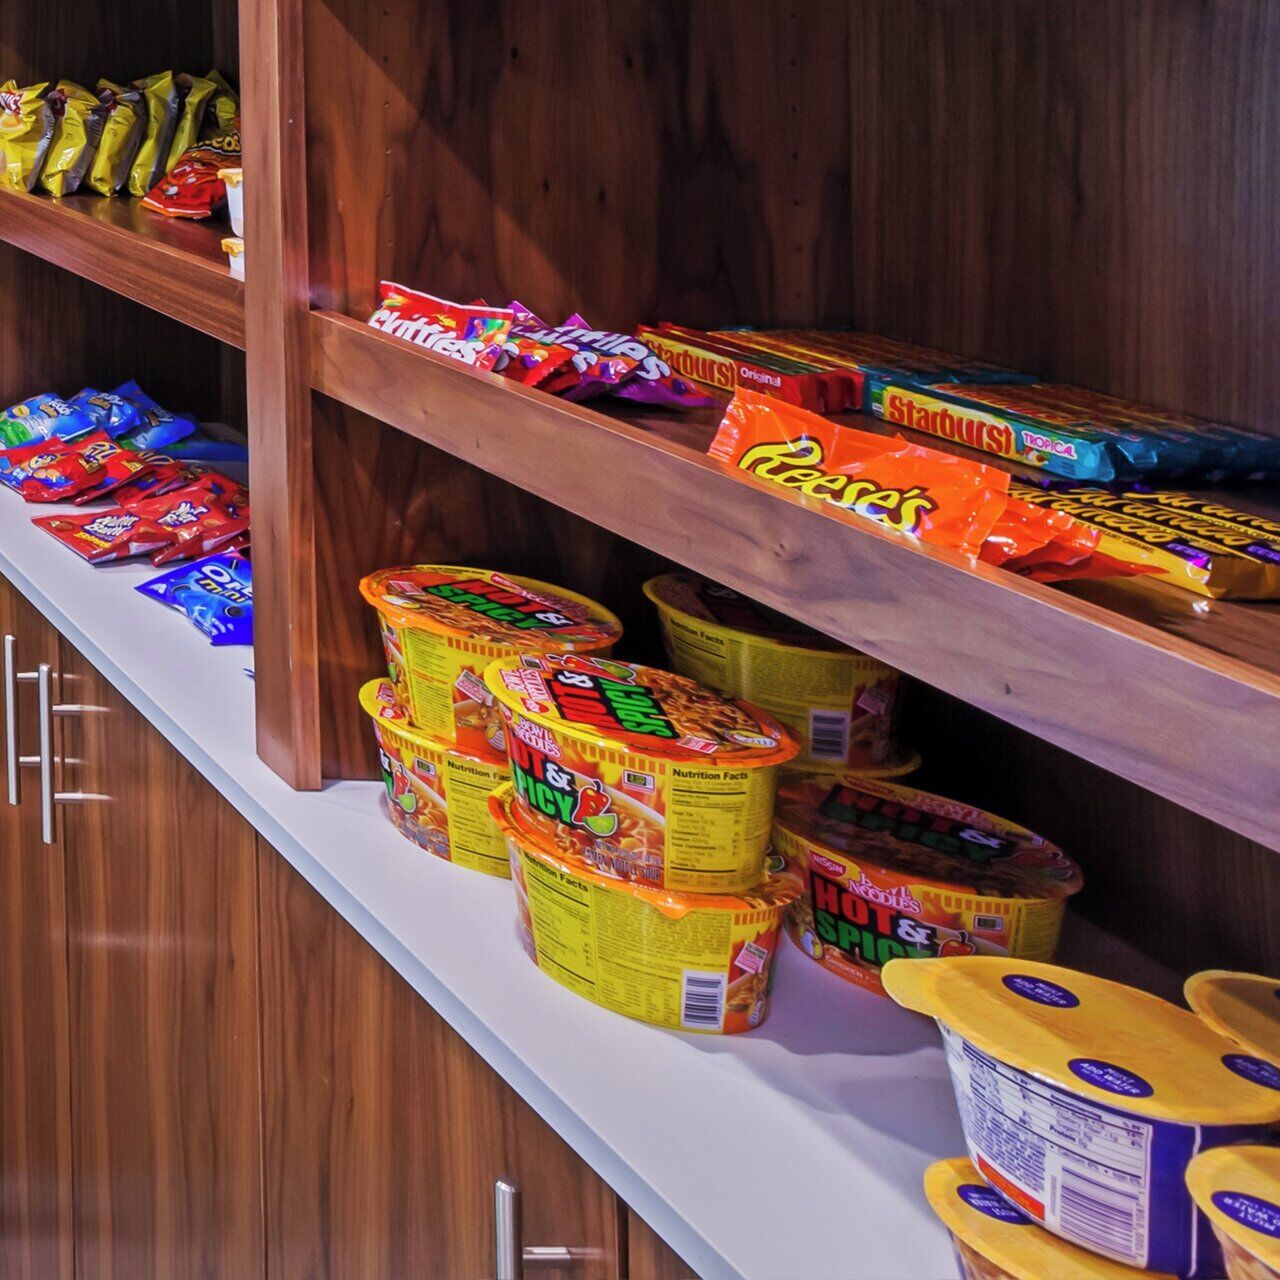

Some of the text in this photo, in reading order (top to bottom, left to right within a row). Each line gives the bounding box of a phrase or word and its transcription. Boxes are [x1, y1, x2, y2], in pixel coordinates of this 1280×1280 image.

[368, 308, 486, 366] Skittles
[646, 340, 781, 389] Starburst Original
[888, 394, 1077, 459] Starburst TROPICAL
[739, 439, 933, 533] Reese's
[426, 584, 555, 631] SPICY
[455, 579, 557, 613] HOT
[699, 629, 725, 646] Facts
[550, 679, 623, 731] HOT
[598, 677, 674, 738] SPICY
[515, 726, 562, 759] NOODLES
[520, 716, 553, 741] BOWL
[447, 759, 491, 780] Nutrition
[546, 762, 572, 792] &
[672, 768, 749, 781] Nutrition Facts
[559, 873, 589, 894] Facts
[847, 878, 921, 915] NOODLES
[813, 872, 932, 946] HOT &
[825, 954, 864, 979] CHICKEN
[1079, 1062, 1141, 1095] ADD WATER
[1049, 1123, 1076, 1142] Protein
